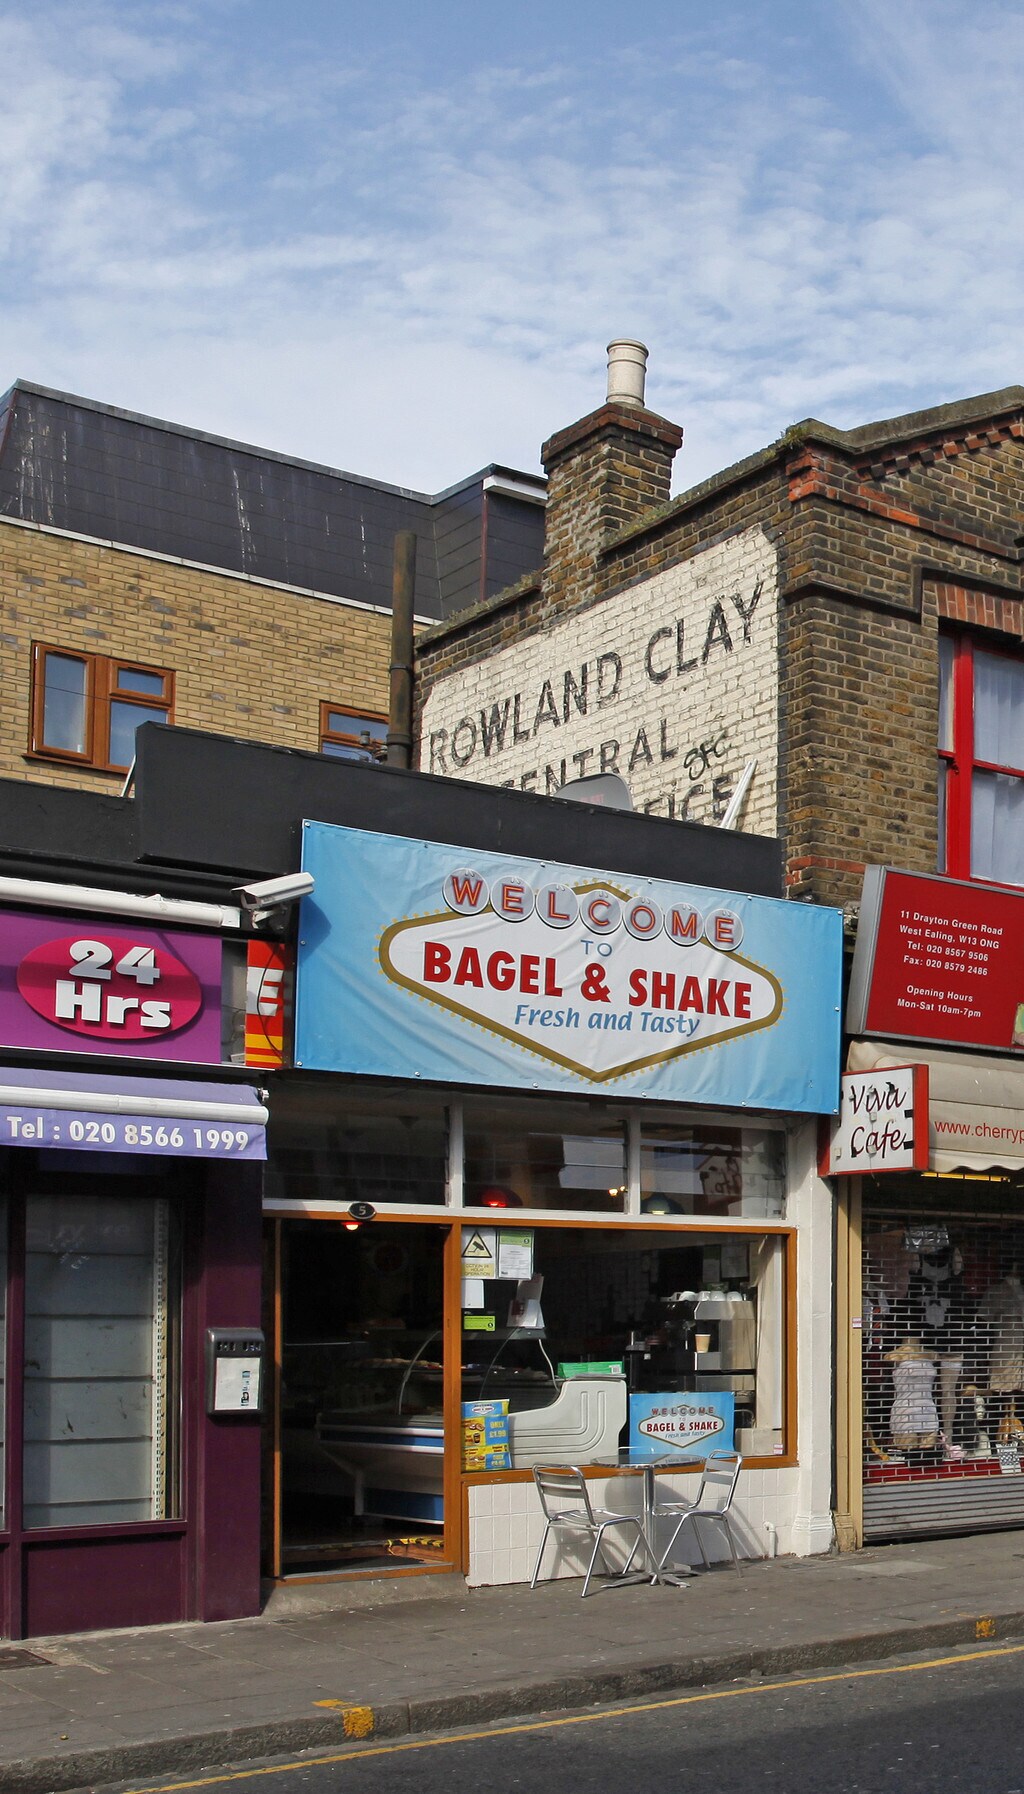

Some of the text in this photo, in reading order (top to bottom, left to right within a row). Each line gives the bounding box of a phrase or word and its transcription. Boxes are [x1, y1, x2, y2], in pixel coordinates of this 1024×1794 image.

[429, 581, 764, 773] ROWLAND CLAY
[502, 718, 678, 796] ENTRAL
[450, 874, 735, 944] WELCOME
[900, 910, 1003, 935] 11 Drayton Green Road
[580, 939, 613, 957] TO
[899, 924, 922, 936] West
[924, 929, 955, 943] Ealing,
[959, 935, 977, 945] W13
[69, 940, 160, 985] 24
[907, 940, 988, 961] Tel: 020 8567 9506
[903, 955, 988, 976] Fax: 020 8579 2486
[423, 941, 752, 1019] BAGEL & SHAKE
[906, 984, 973, 1002] Opening Hours
[55, 980, 171, 1028] Hrs
[897, 998, 981, 1017] Mon-Sat 10am-7pm
[514, 1004, 700, 1037] Fresh and Tasty
[851, 1083, 906, 1114] Viva
[7, 1116, 44, 1139] Tel
[69, 1120, 116, 1143] 020
[124, 1124, 183, 1147] 8566
[193, 1129, 249, 1150] 1999
[851, 1119, 906, 1158] Cafe
[359, 1205, 366, 1215] 5
[652, 1406, 714, 1416] WELCOME
[646, 1421, 718, 1432] BAGEL & SHAKE
